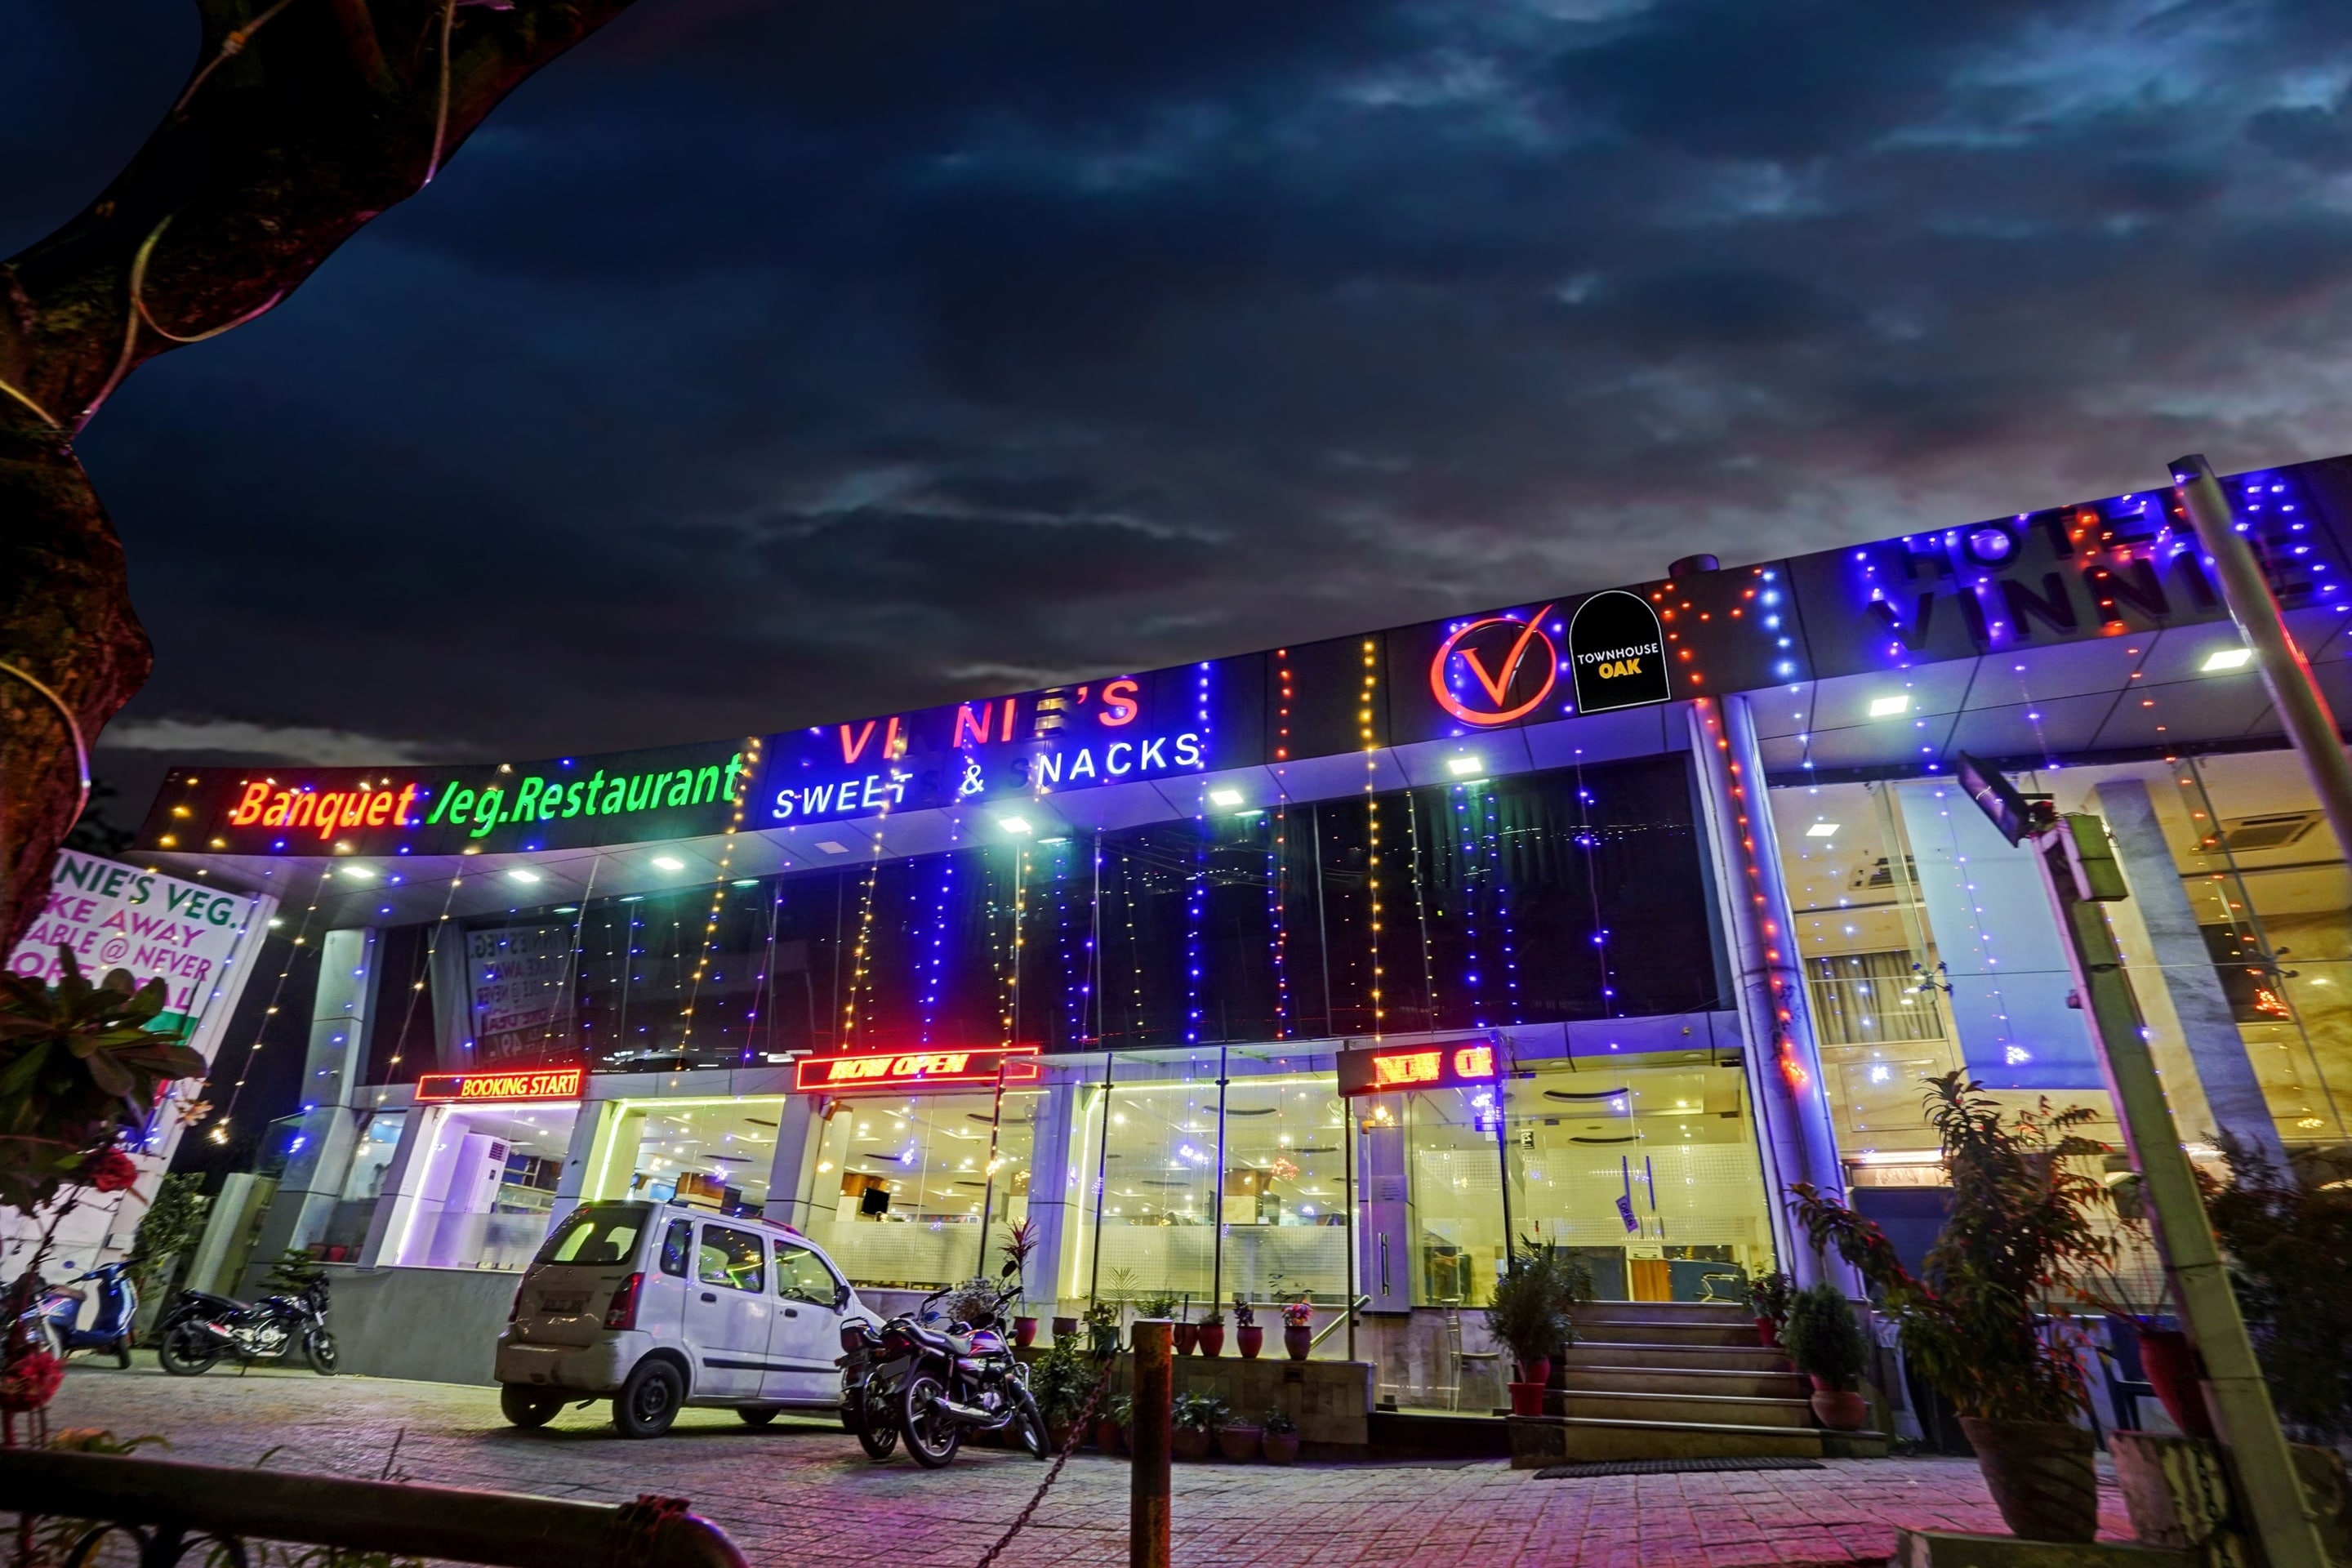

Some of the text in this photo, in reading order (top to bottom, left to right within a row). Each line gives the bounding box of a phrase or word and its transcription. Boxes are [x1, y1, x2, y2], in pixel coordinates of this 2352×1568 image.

[1577, 642, 1659, 666] TOWNHOUSE
[1598, 657, 1642, 679] OAK
[960, 764, 985, 795] &
[231, 782, 417, 840] Banquet
[54, 854, 238, 929] NIE'S VEG.
[42, 892, 207, 949] KE AWAY
[25, 921, 212, 982] ABLE @ NEVER
[827, 1054, 970, 1080] NOW OPEN
[461, 1075, 577, 1096] BOOKING START
